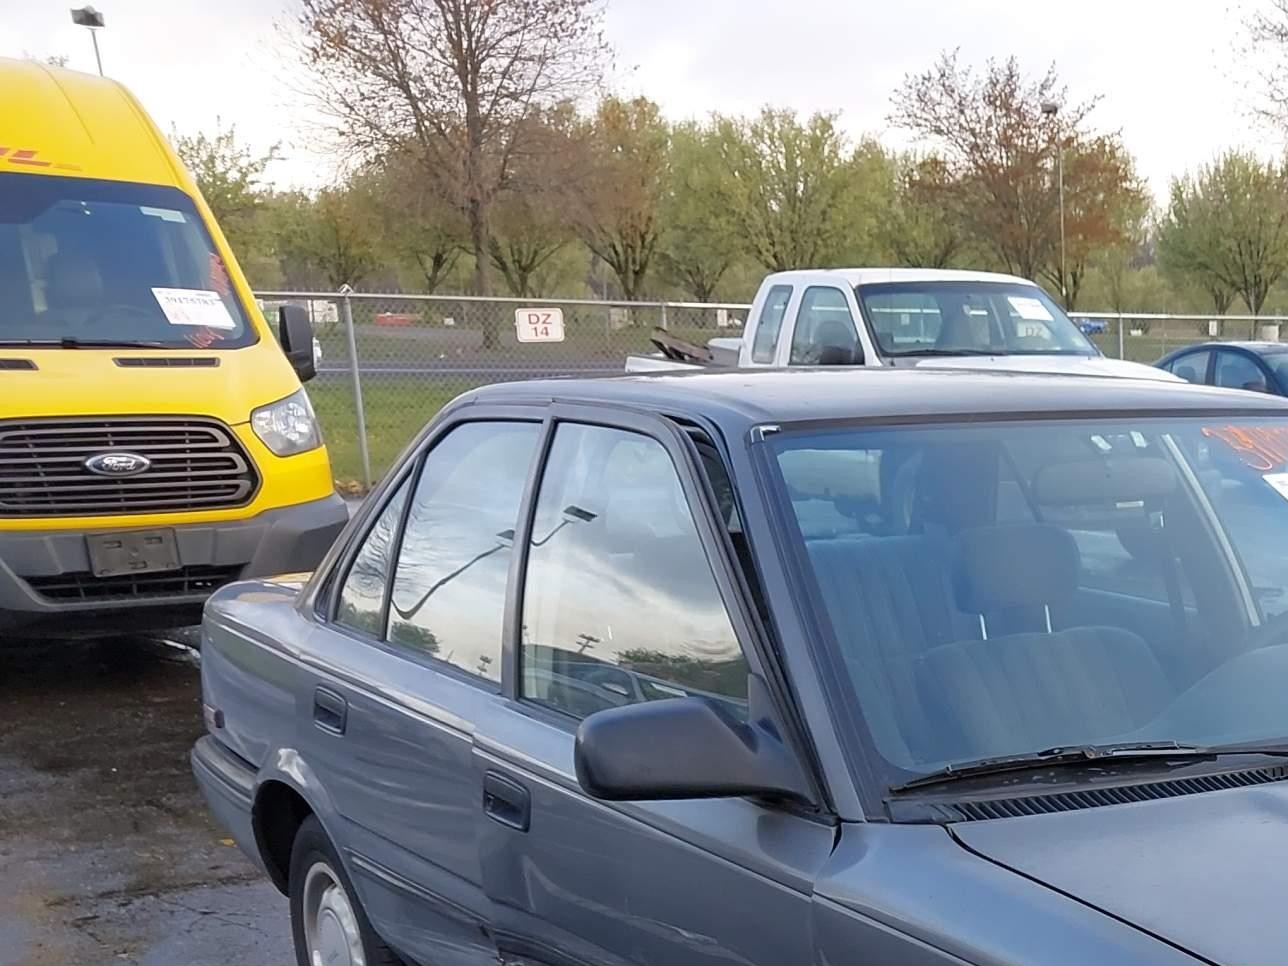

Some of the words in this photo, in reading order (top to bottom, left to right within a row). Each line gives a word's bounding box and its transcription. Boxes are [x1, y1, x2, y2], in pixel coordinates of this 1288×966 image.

[527, 313, 553, 325] DZ
[531, 326, 549, 337] 14
[102, 456, 136, 471] Ford
